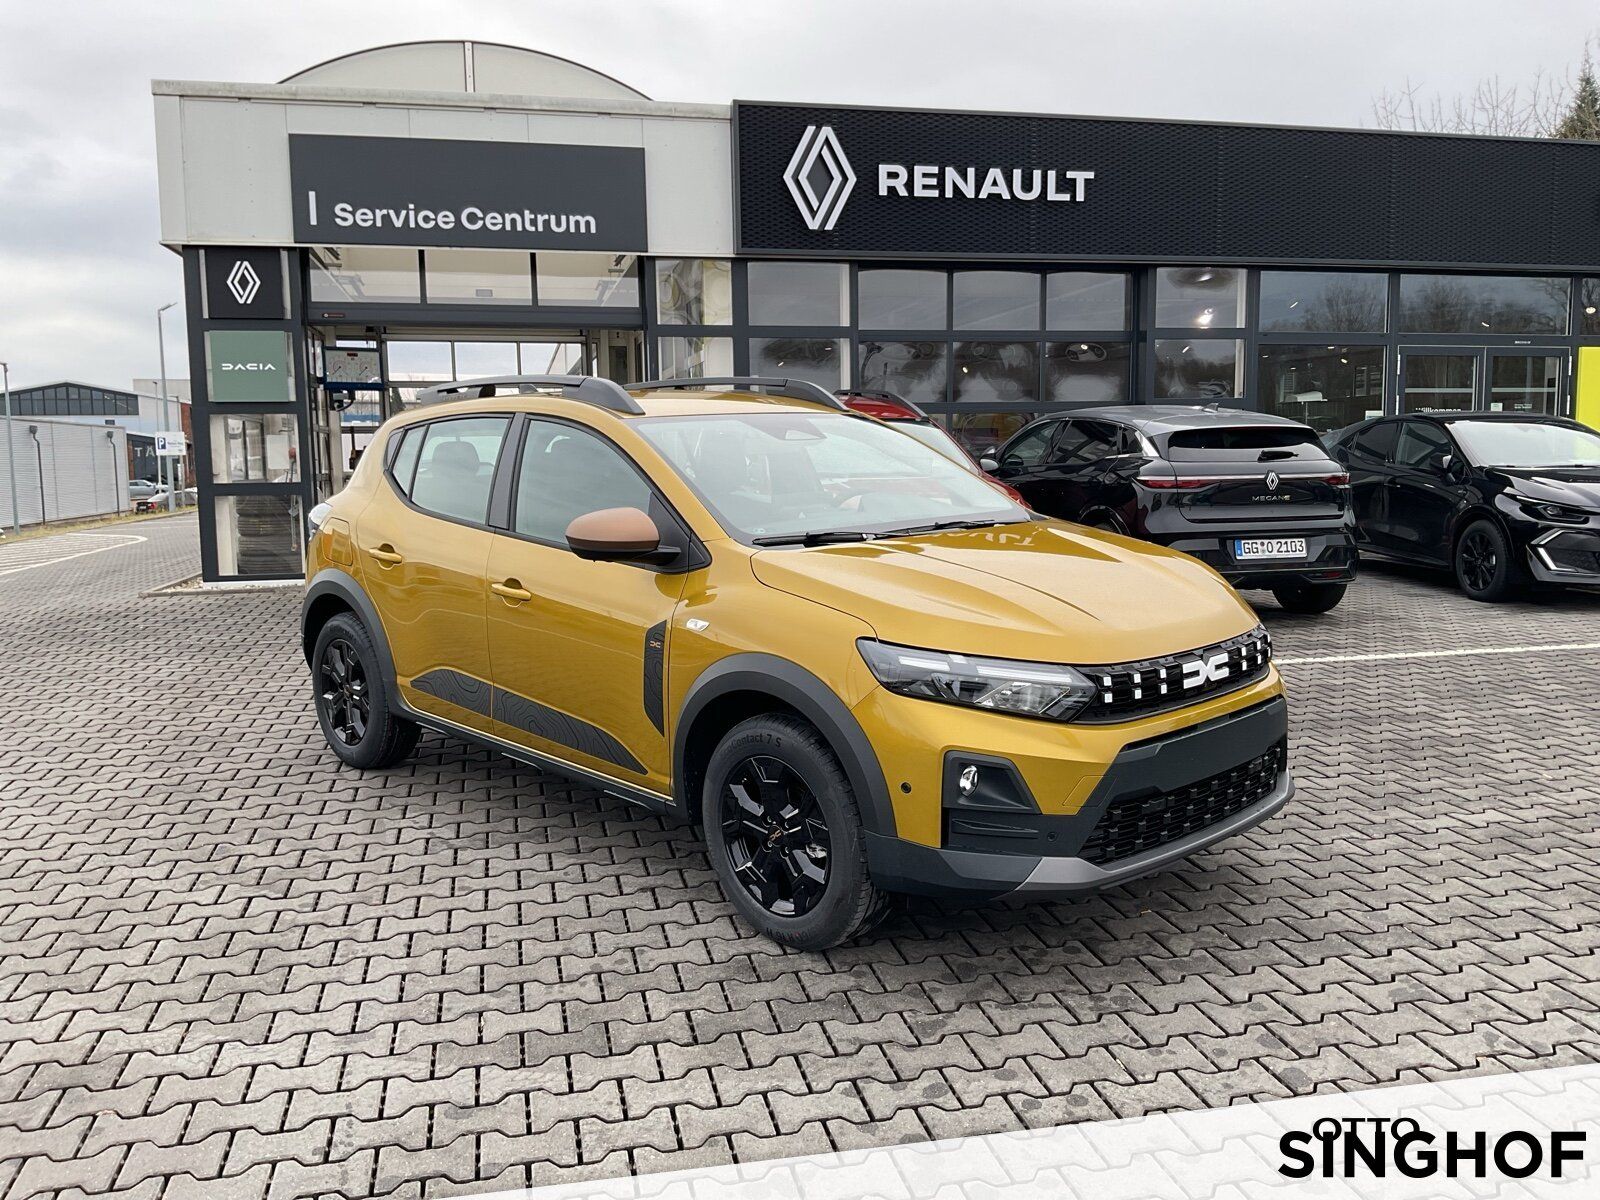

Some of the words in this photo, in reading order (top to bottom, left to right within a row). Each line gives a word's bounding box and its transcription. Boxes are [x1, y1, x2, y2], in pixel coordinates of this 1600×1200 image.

[878, 164, 1095, 202] RENAULT
[334, 203, 455, 229] Service
[460, 206, 596, 233] Centrum
[221, 363, 276, 371] DACIA
[1243, 541, 1259, 554] GG
[1276, 540, 1304, 553] 2103
[766, 733, 772, 744] 7
[775, 737, 782, 748] S
